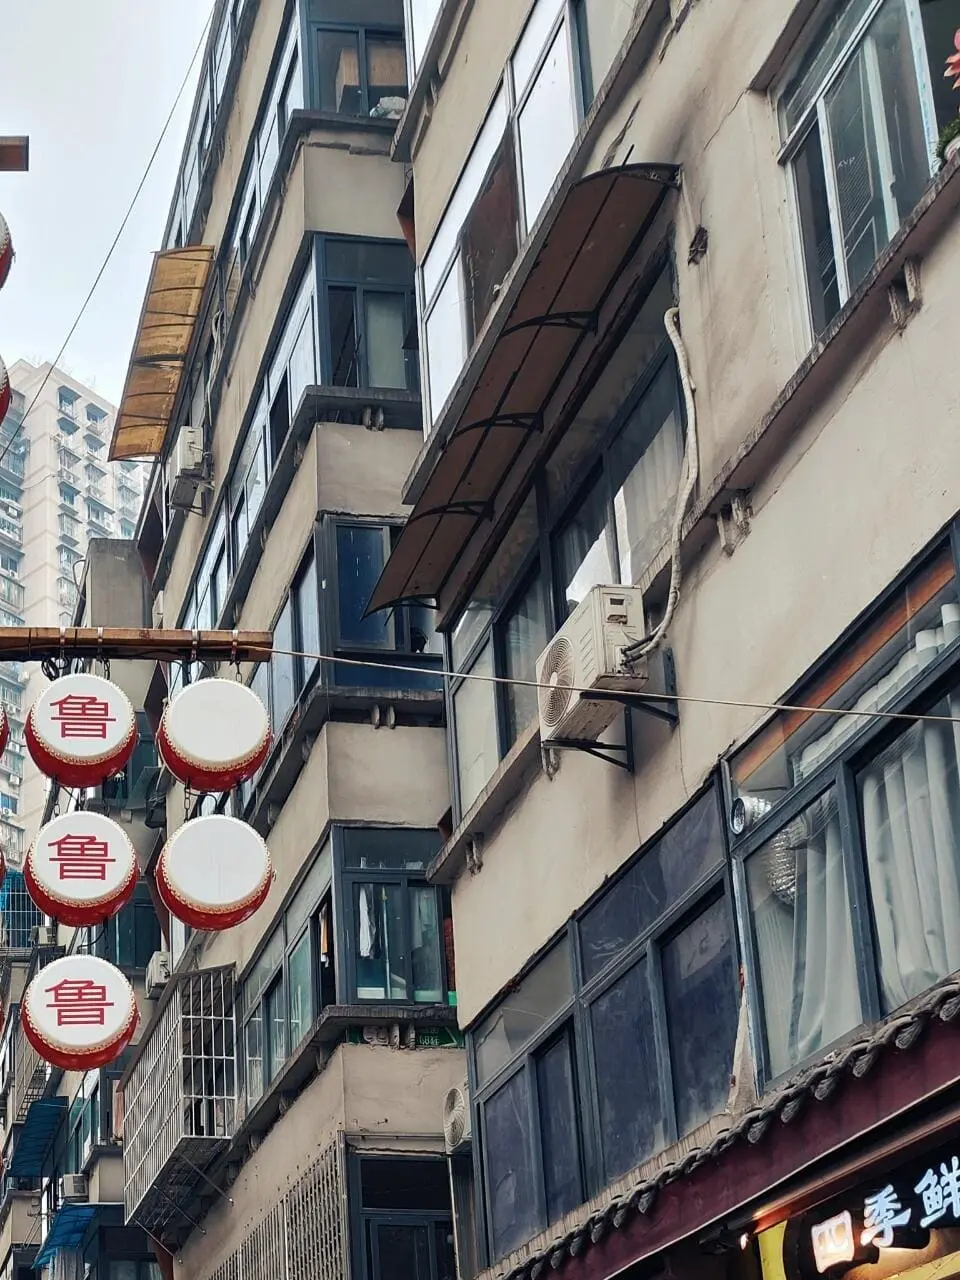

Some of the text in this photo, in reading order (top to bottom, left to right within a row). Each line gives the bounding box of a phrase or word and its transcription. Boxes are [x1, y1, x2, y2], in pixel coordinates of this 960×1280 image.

[49, 694, 116, 739] 鲁
[48, 834, 116, 881] 鲁
[45, 979, 115, 1026] 鲁
